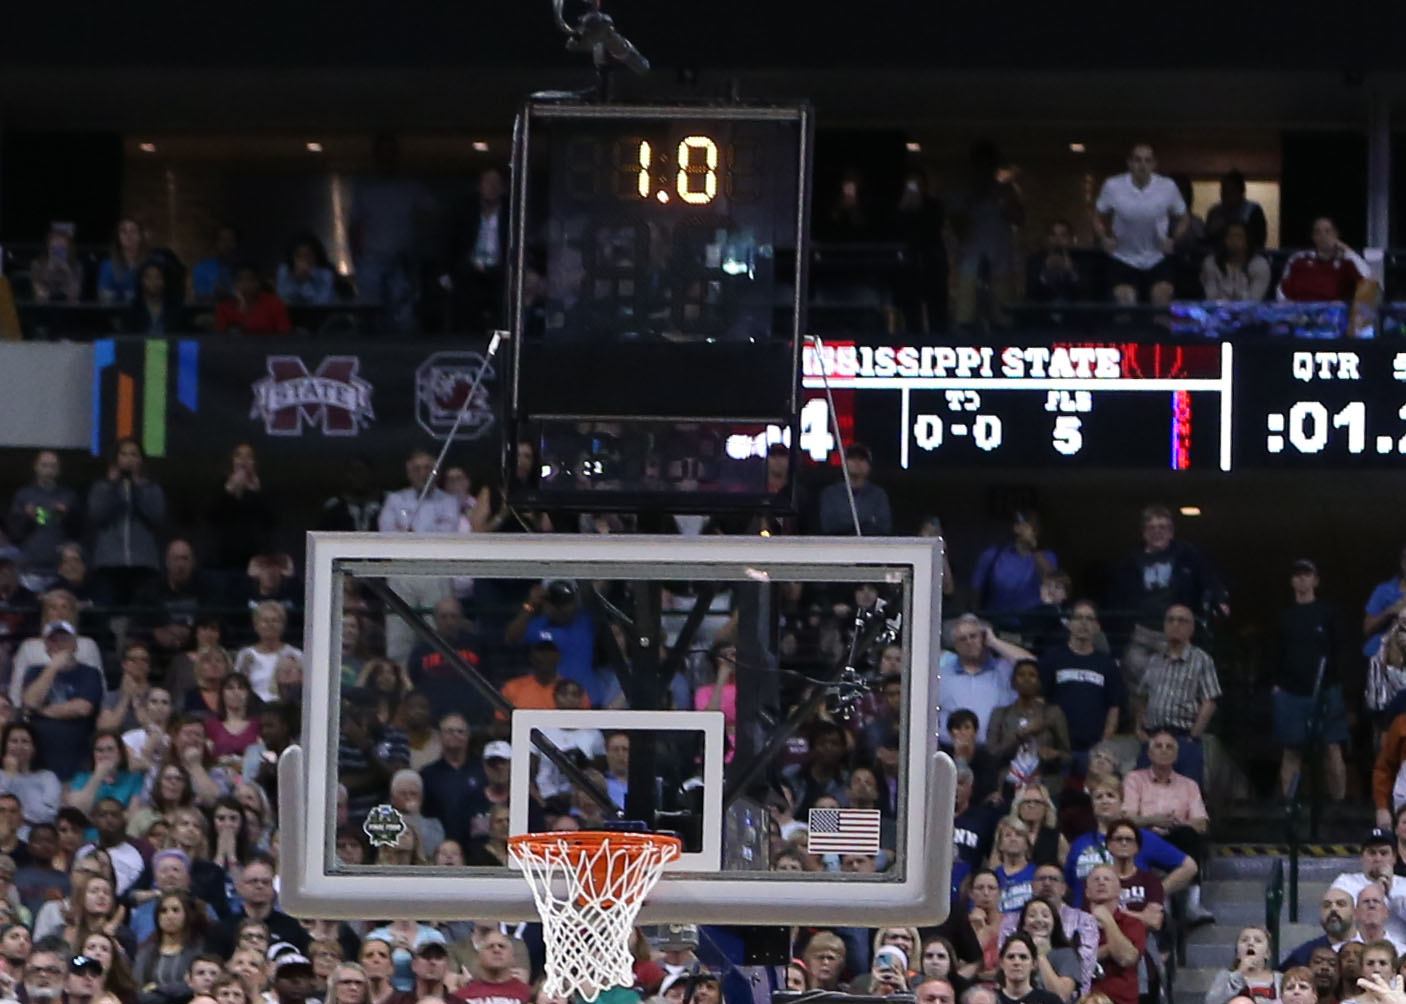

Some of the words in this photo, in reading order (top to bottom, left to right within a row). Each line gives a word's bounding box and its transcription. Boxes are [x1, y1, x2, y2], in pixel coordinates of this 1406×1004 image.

[637, 136, 718, 204] 1.0
[1001, 347, 1121, 378] STATE
[1293, 351, 1360, 382] QTR
[1053, 415, 1083, 455] 5
